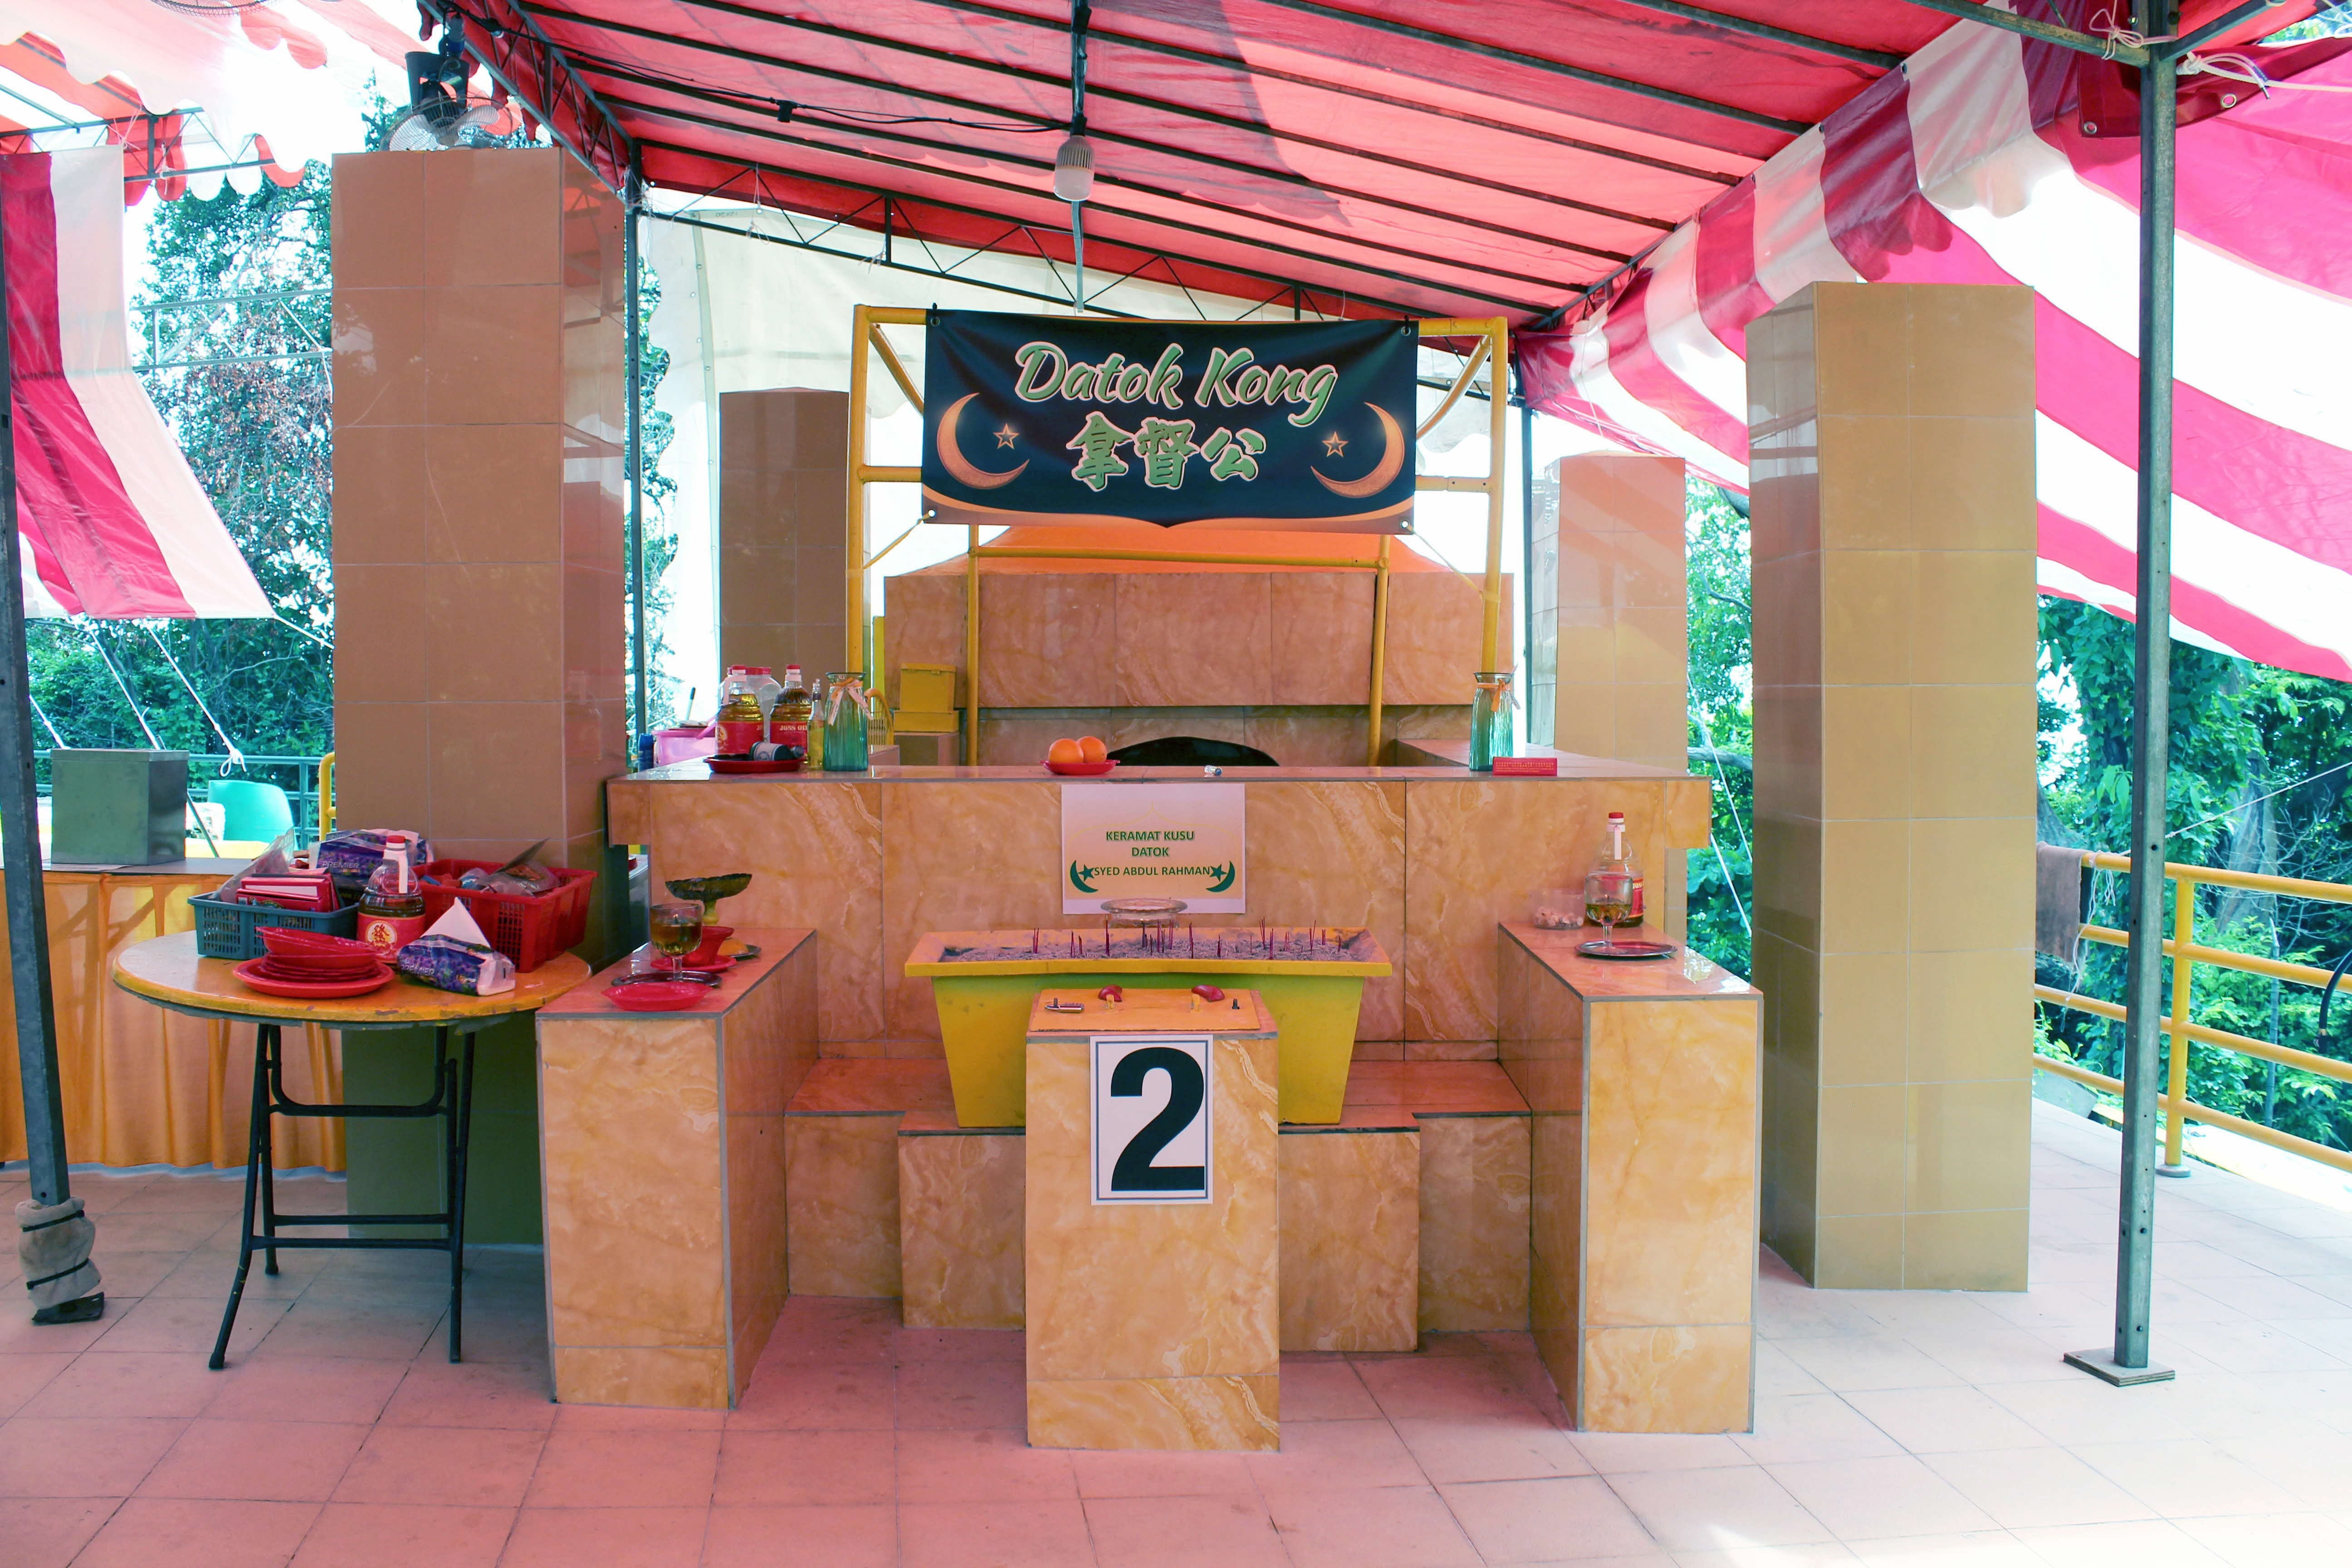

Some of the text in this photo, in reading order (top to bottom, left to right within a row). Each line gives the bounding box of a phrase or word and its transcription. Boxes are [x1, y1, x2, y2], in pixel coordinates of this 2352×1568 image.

[1015, 341, 1338, 426] Datok Kong
[1066, 411, 1267, 492] 拿督公
[1106, 831, 1195, 840] KERAMAT KUSU
[1132, 847, 1169, 857] DATOK
[1094, 867, 1210, 876] SYED ABDUL RAHMAN
[1111, 1046, 1205, 1191] 2
